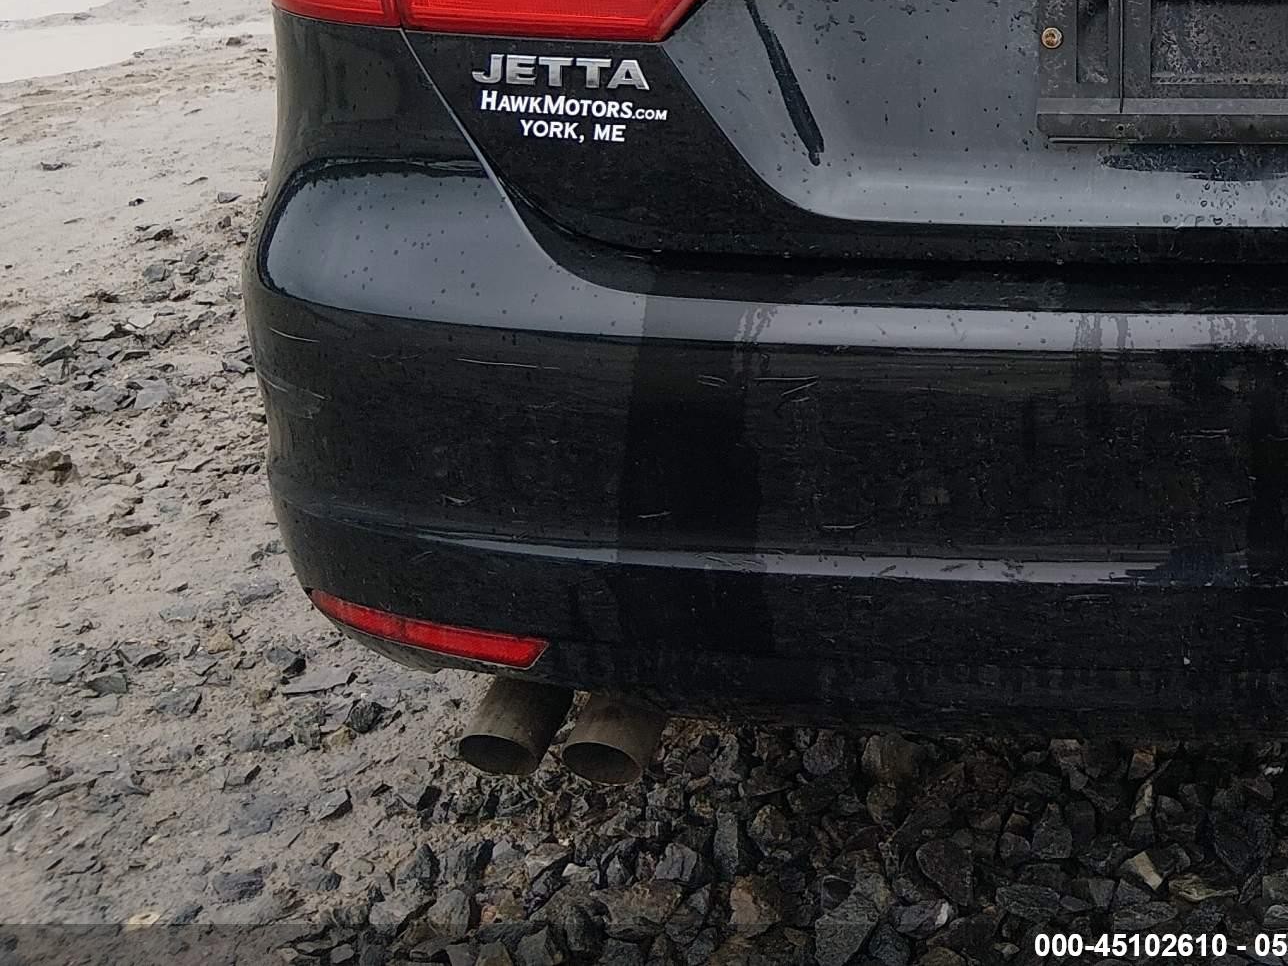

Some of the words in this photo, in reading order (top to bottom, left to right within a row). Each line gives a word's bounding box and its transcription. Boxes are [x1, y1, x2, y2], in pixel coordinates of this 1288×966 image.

[472, 54, 650, 91] JETTA
[520, 119, 585, 143] YORK,
[593, 124, 626, 142] ME
